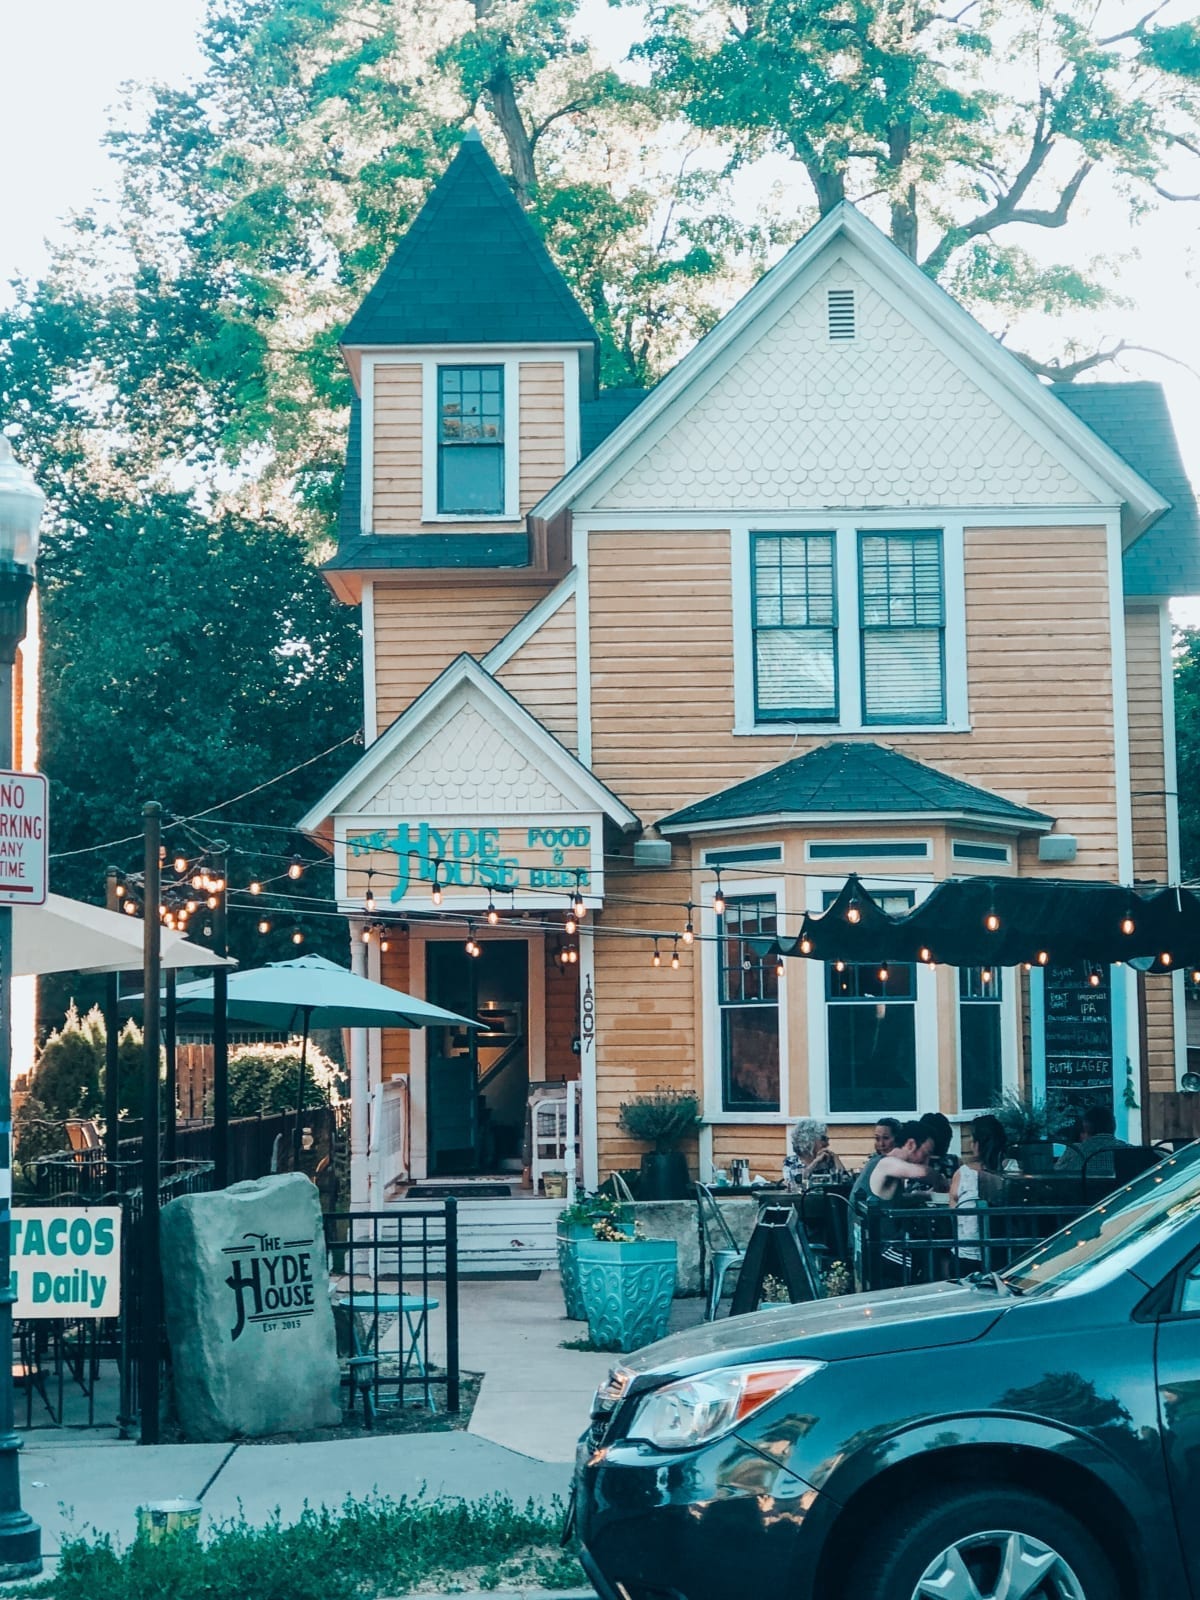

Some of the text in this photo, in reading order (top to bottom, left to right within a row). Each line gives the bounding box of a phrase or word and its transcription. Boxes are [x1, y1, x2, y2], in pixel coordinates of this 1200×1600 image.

[0, 784, 25, 809] NO
[528, 827, 591, 847] FOOD
[0, 841, 24, 858] ANY
[349, 823, 500, 884] THE HYDE
[552, 848, 564, 866] &
[0, 861, 26, 878] TIME
[530, 868, 591, 888] BEER
[582, 972, 594, 1053] 1607
[1080, 1003, 1097, 1014] IPA
[1075, 1060, 1110, 1073] LAGER
[10, 1217, 114, 1256] TACOS
[243, 1232, 281, 1252] THE
[32, 1268, 107, 1308] Daily
[225, 1253, 313, 1309] HYDE
